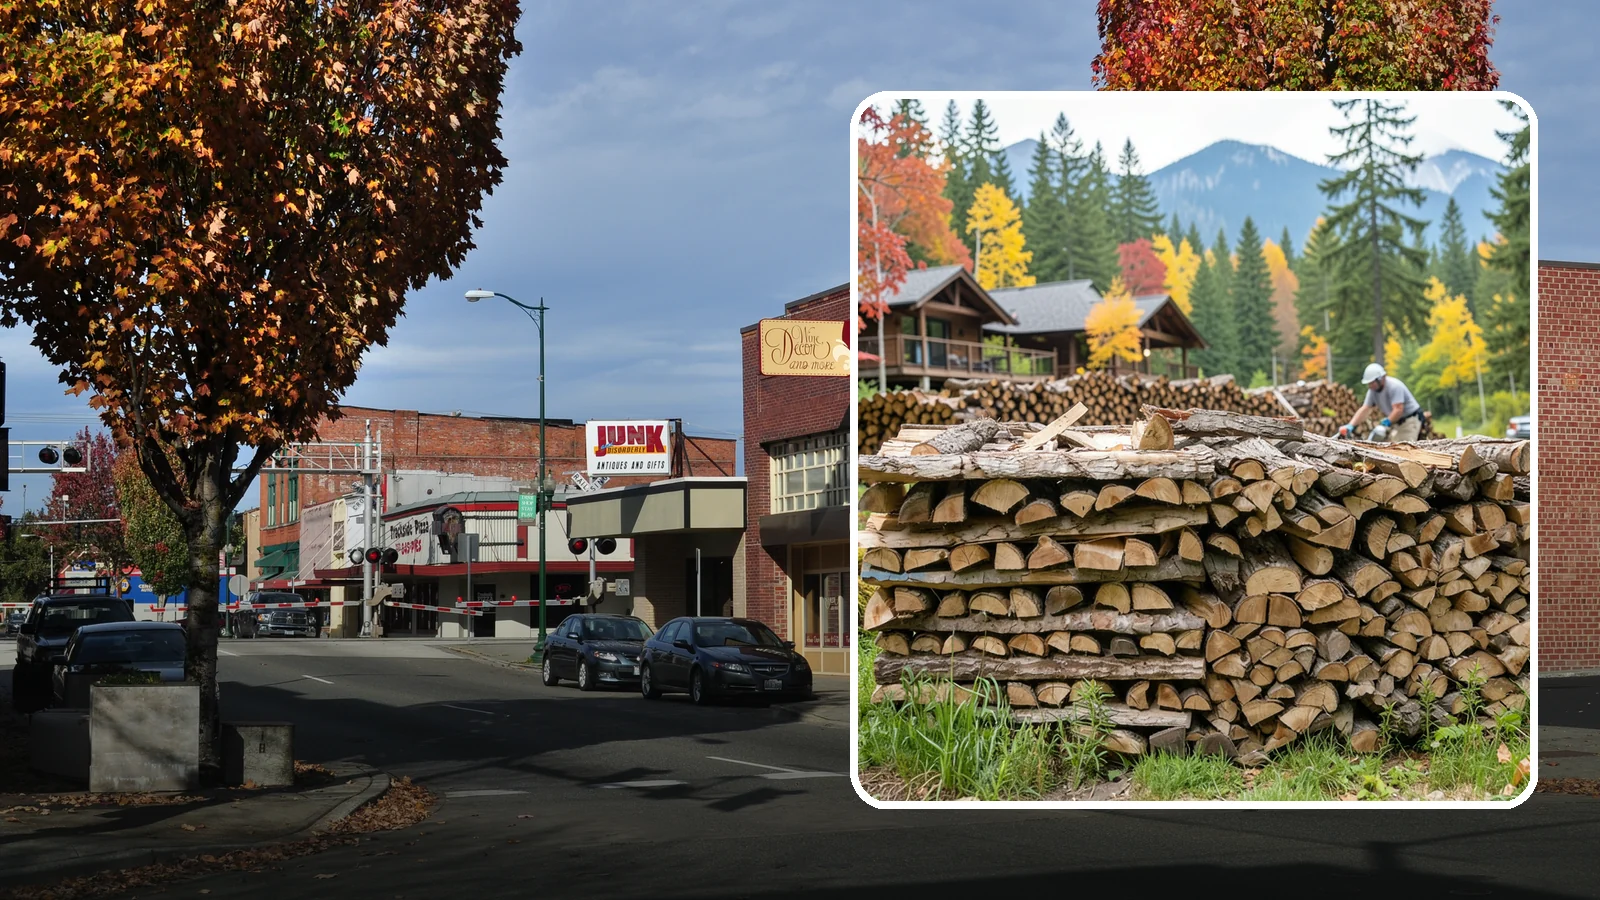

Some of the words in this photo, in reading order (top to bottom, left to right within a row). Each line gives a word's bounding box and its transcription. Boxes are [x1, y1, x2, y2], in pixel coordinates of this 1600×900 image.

[765, 328, 830, 365] Decor
[596, 426, 664, 456] JUNK
[607, 446, 646, 454] DISORDERLY
[596, 461, 628, 470] ANTIQUES
[631, 461, 644, 470] AND
[647, 460, 665, 469] GIFTS
[390, 521, 413, 539] Trackside
[414, 519, 429, 534] Pizza
